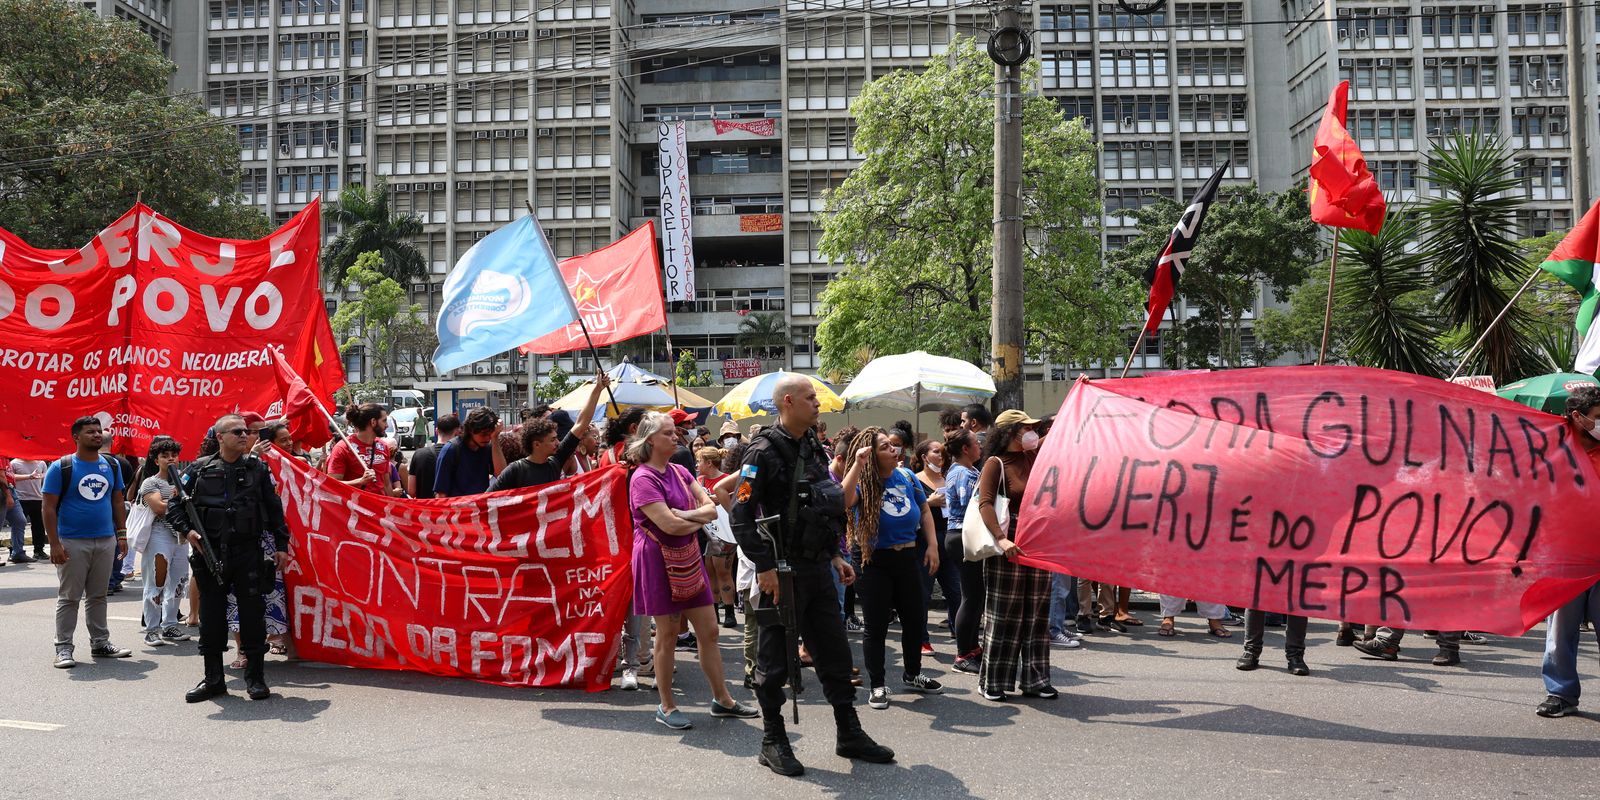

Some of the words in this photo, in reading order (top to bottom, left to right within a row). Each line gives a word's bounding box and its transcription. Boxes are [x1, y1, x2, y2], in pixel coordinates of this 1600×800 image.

[108, 274, 283, 332] POVO
[0, 349, 74, 372] ROTAR
[83, 350, 103, 370] OS
[108, 345, 171, 368] PLANOS
[30, 379, 57, 399] DE
[67, 373, 128, 398] GULNAR
[133, 374, 142, 392] E
[150, 376, 223, 396] CASTRO
[1455, 377, 1494, 389] EDICINA
[1302, 391, 1585, 489] GULNAR!
[265, 446, 620, 559] NFERMAGEM
[1034, 466, 1059, 507] A
[1077, 457, 1219, 550] UERJ
[1231, 495, 1253, 542] É
[1269, 510, 1314, 549] DO
[1341, 484, 1541, 577] POVO!
[307, 532, 562, 627] CONTRA
[565, 564, 613, 584] FENF
[579, 587, 605, 600] NA
[1253, 556, 1412, 622] MEPR
[566, 602, 605, 619] LUTA
[407, 623, 459, 668] DA
